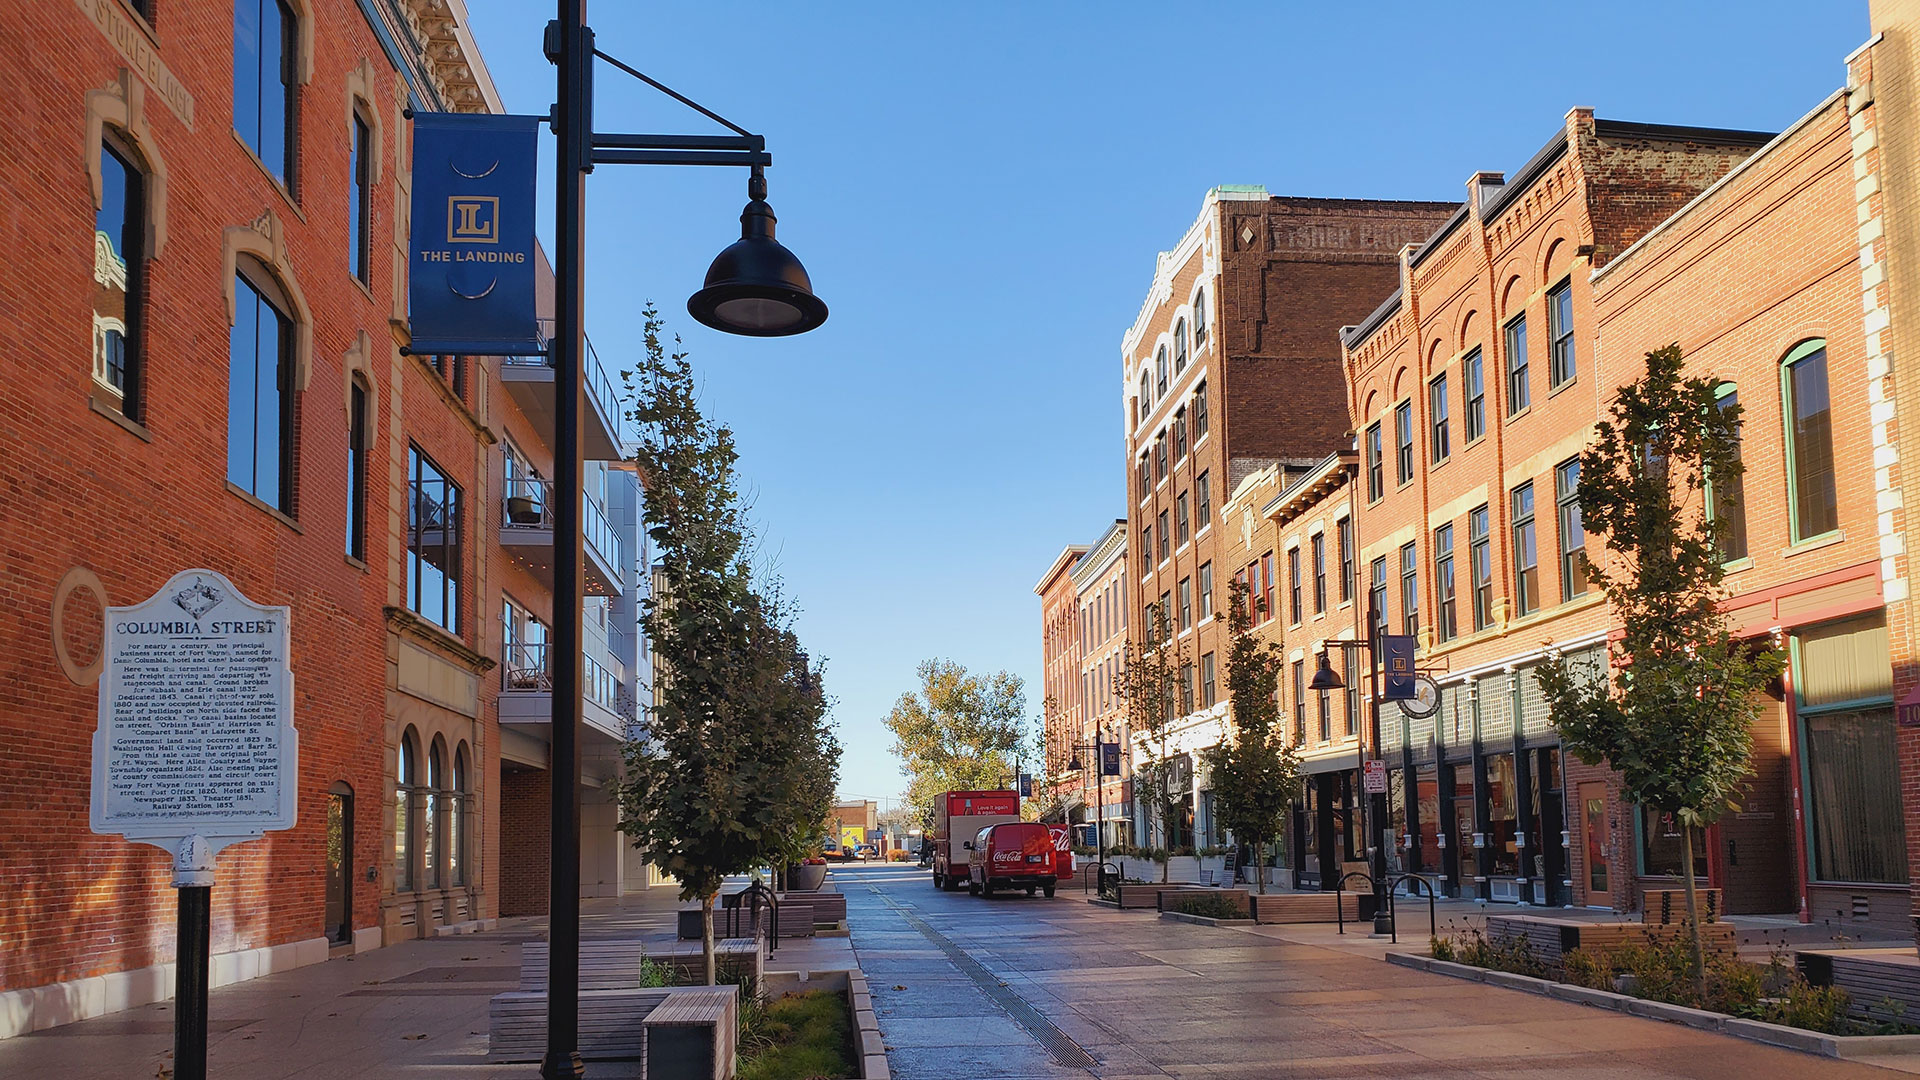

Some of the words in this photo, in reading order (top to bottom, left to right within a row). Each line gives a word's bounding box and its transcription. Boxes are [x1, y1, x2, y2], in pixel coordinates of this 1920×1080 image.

[421, 251, 451, 262] THE
[456, 251, 525, 263] LANDING
[116, 622, 200, 634] COLUMBIA
[211, 622, 276, 634] STREET
[144, 643, 167, 651] nearly
[139, 673, 165, 681] freight
[219, 672, 254, 680] departing
[124, 680, 165, 688] stagecoach
[148, 708, 182, 716] buildings
[212, 728, 246, 736] Lafayette
[112, 745, 155, 753] Washington
[220, 751, 249, 759] original
[210, 758, 235, 766] County
[146, 766, 183, 774] organized
[209, 781, 243, 789] appeared
[134, 796, 174, 804] Newspaper
[153, 803, 182, 811] Railway
